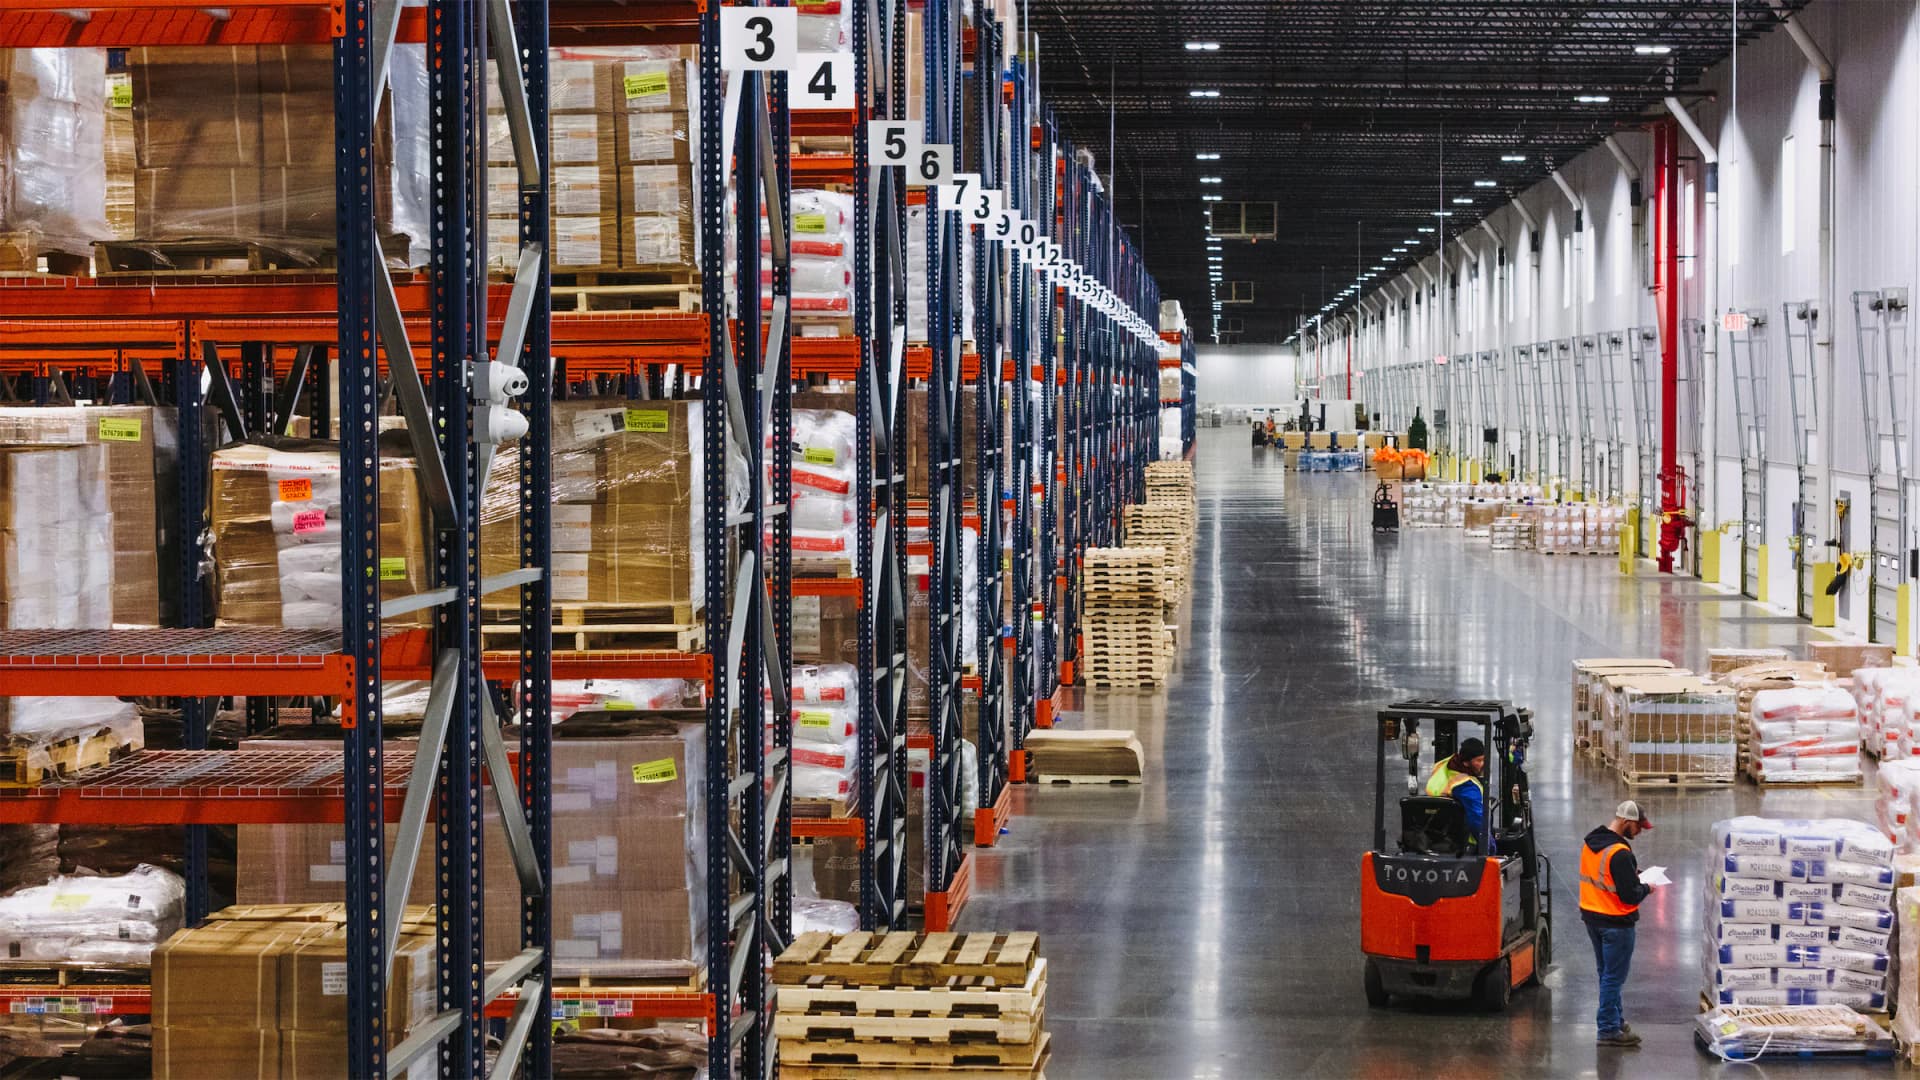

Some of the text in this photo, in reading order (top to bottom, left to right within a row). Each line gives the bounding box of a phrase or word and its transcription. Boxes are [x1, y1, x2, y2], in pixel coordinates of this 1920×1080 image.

[744, 16, 775, 62] 3
[808, 61, 836, 101] 4
[884, 128, 907, 160] 5
[920, 150, 940, 180] 6
[953, 180, 968, 205] 7
[1725, 315, 1745, 329] EXIT
[1384, 865, 1468, 882] TOYOTA
